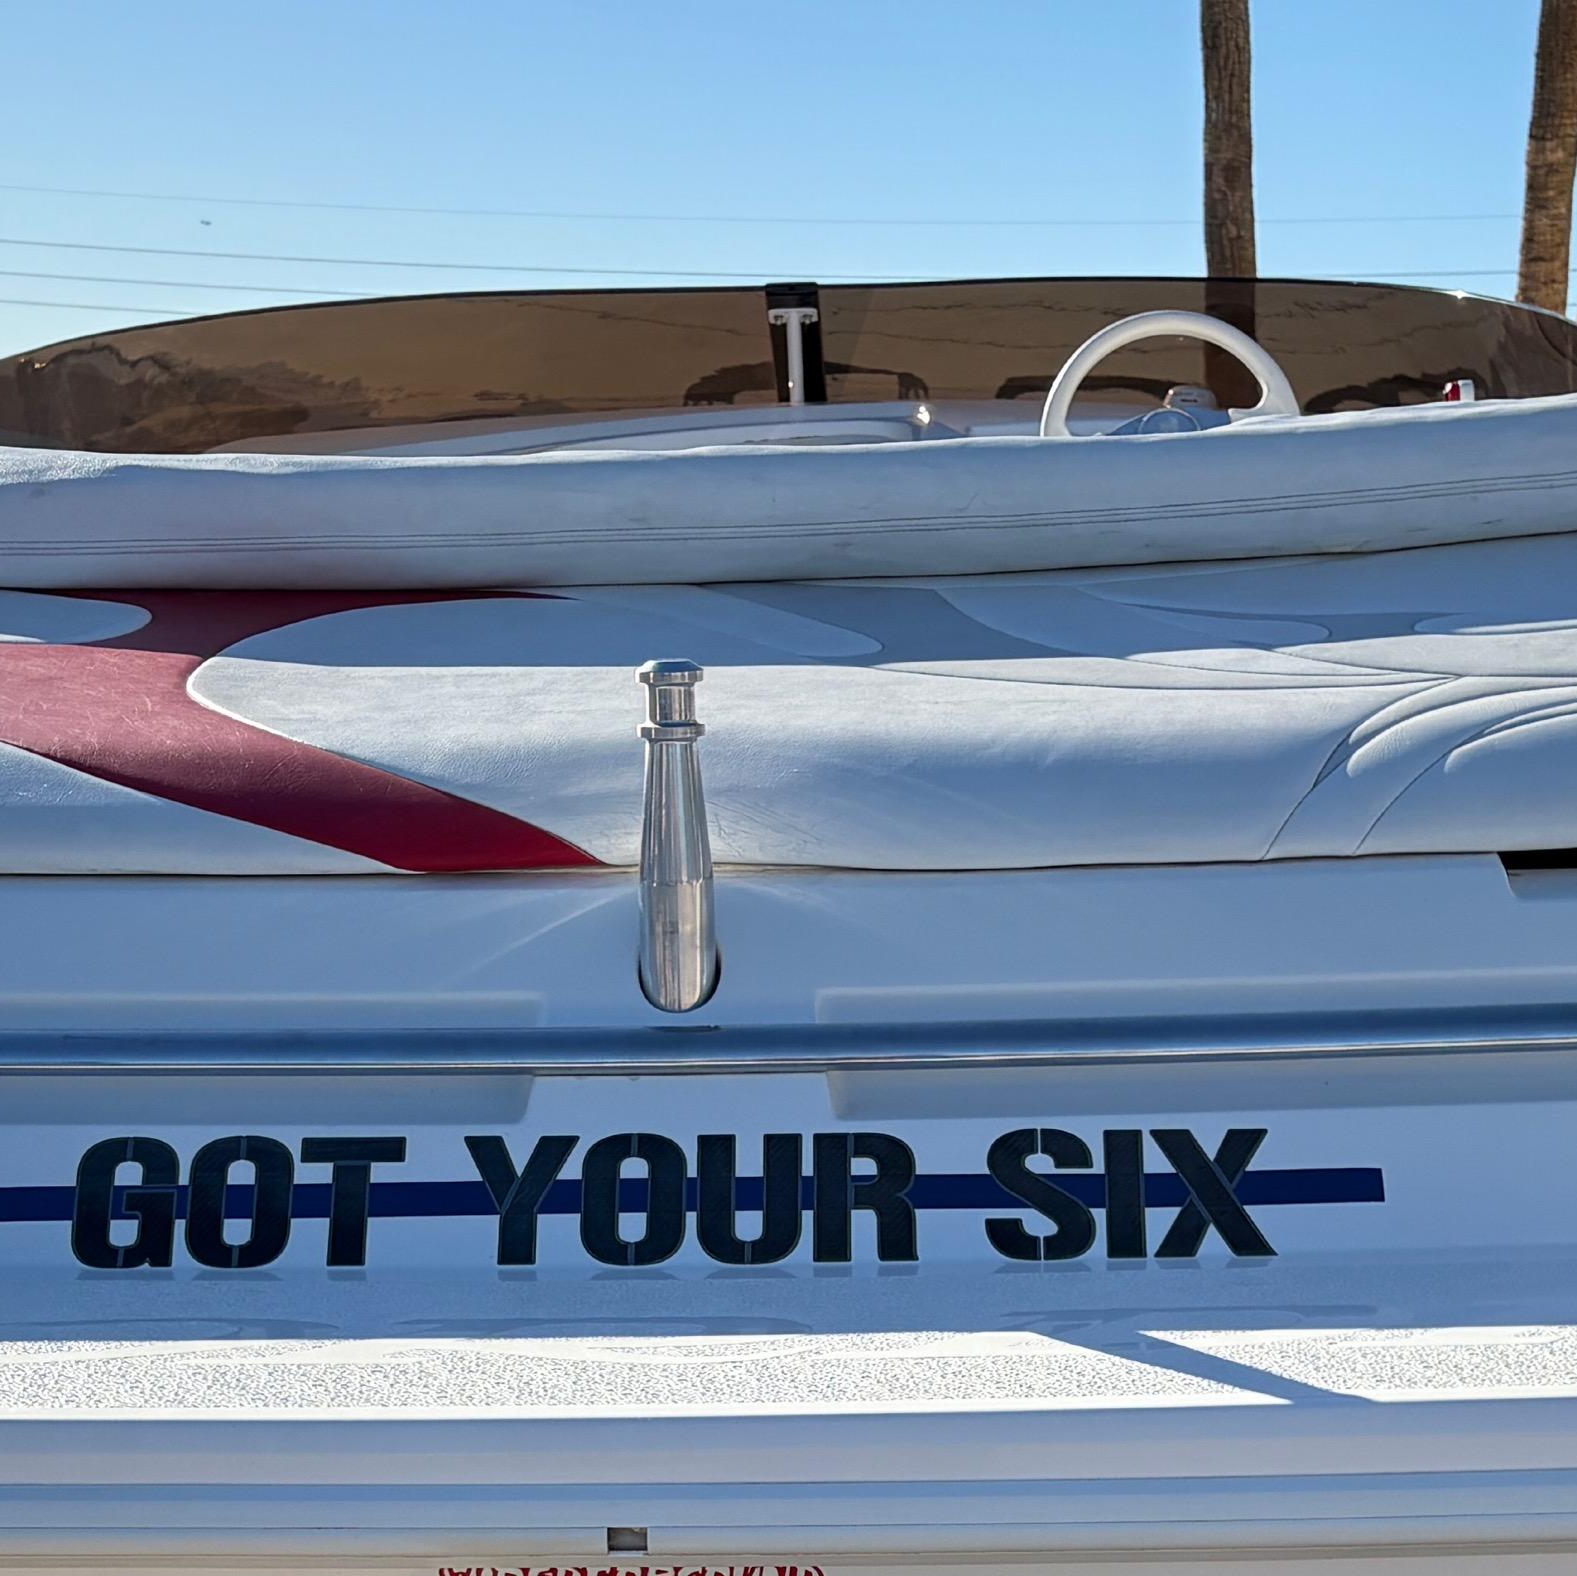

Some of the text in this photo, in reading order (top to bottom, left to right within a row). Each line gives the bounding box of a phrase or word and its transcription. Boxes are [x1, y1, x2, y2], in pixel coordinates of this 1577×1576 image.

[71, 1128, 1278, 1268] GOT YOUR SIX
